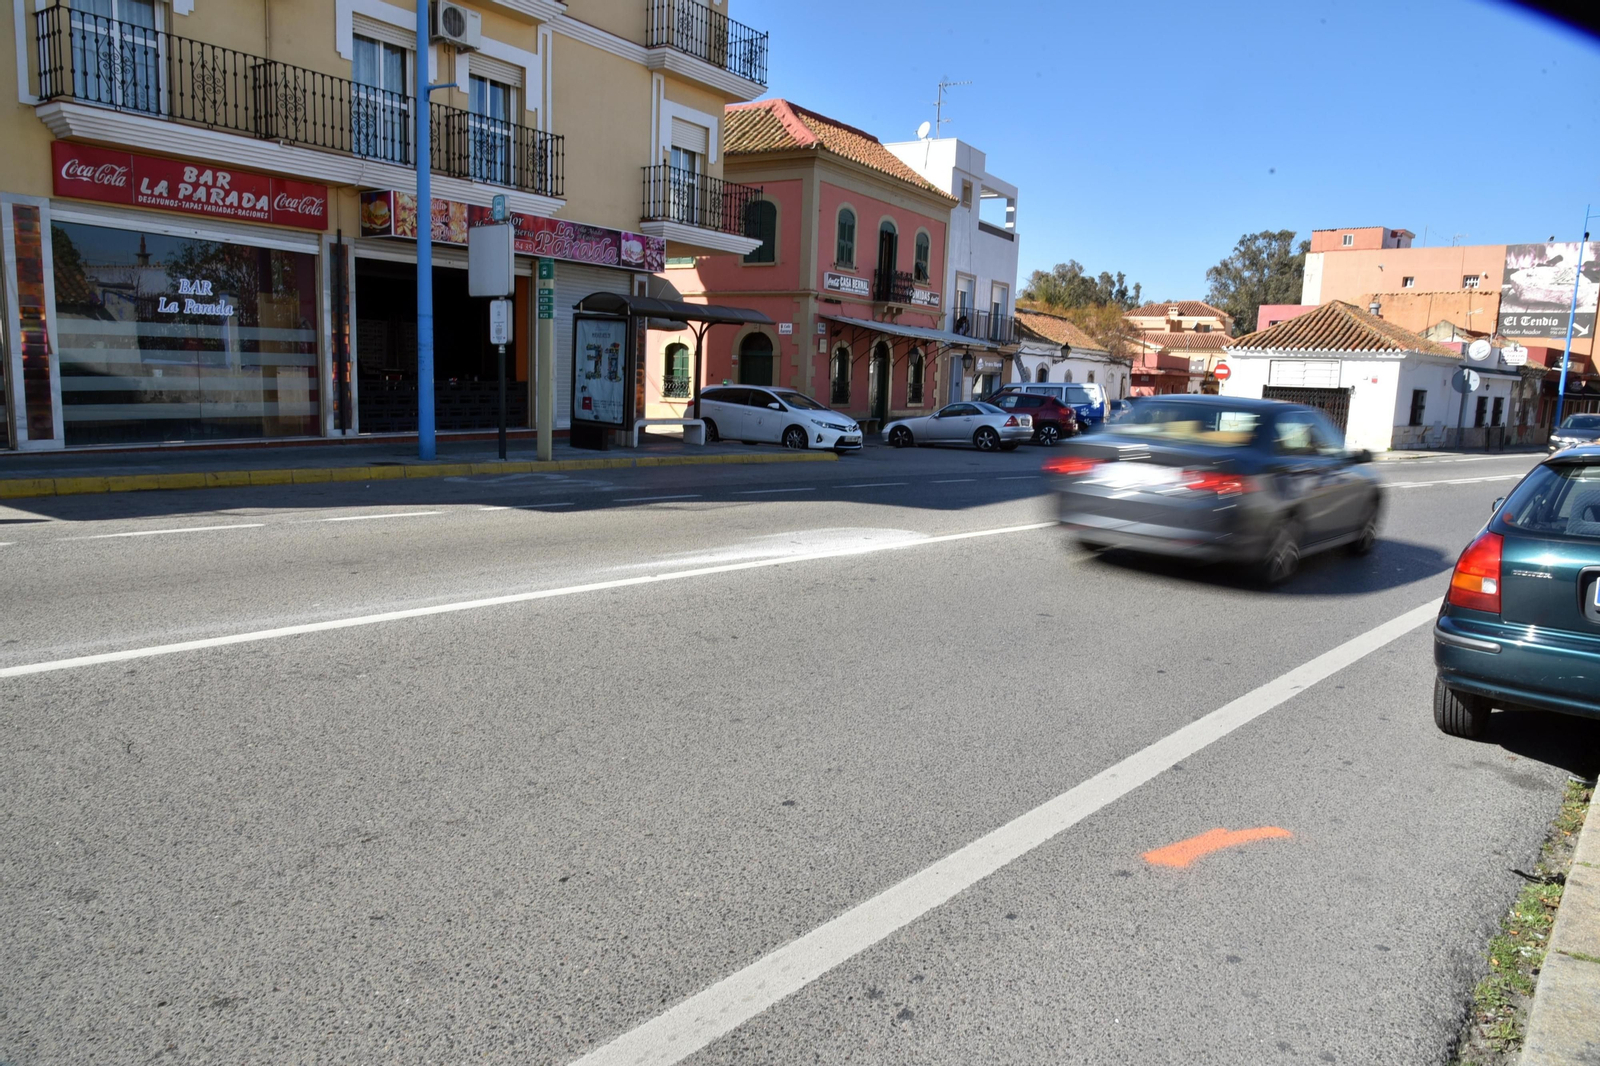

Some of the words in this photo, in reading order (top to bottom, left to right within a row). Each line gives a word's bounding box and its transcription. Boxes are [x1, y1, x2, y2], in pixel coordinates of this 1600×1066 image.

[61, 159, 129, 187] Coca-Cola
[183, 166, 232, 189] BAR
[140, 177, 169, 197] LA
[178, 182, 269, 211] PARADA
[274, 191, 325, 216] Coca-Cola
[554, 222, 574, 240] La
[535, 230, 619, 265] Parada
[178, 279, 214, 296] BAR
[840, 276, 851, 288] CASA
[852, 279, 869, 291] BERNAL
[158, 296, 179, 313] La
[183, 298, 234, 316] Parada
[1503, 315, 1517, 326] El
